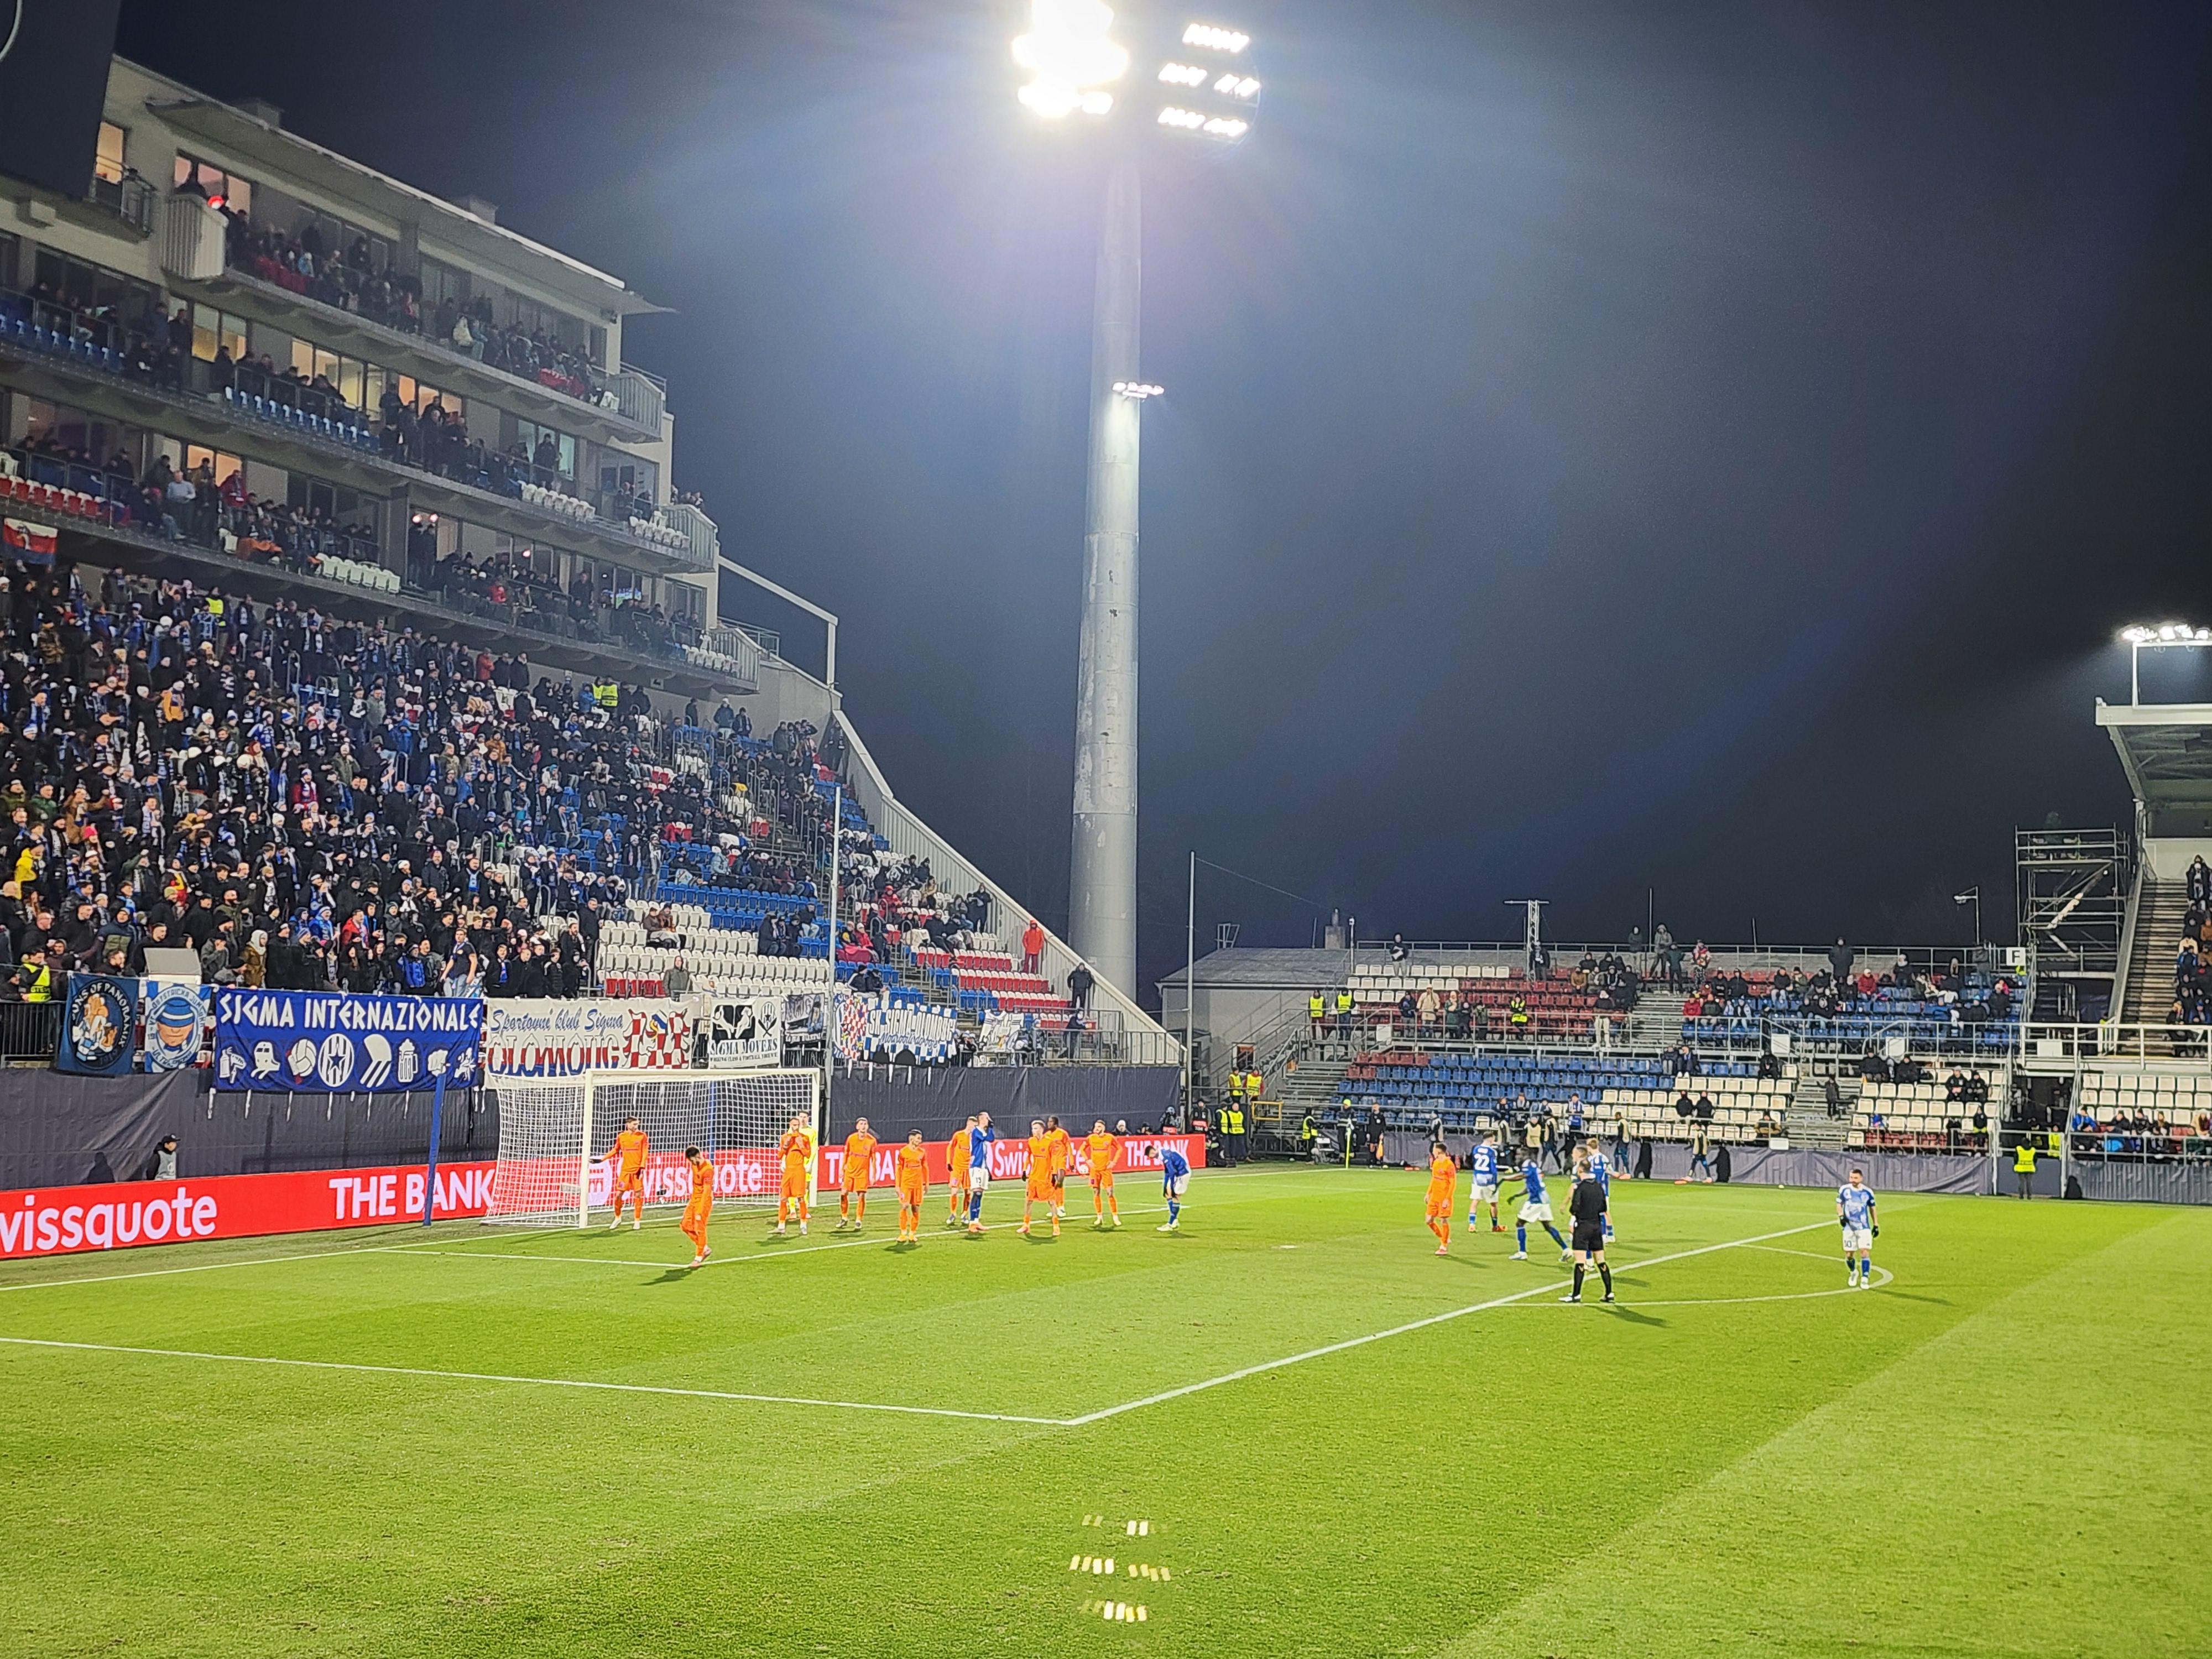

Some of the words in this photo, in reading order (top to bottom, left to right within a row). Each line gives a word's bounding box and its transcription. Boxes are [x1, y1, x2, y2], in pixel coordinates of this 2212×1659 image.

[2012, 950, 2020, 963] F
[90, 982, 102, 994] OF
[219, 993, 294, 1028] SIGMA
[304, 998, 481, 1031] INTERNAZIONALE
[555, 1006, 582, 1031] klub
[585, 1008, 623, 1037] Sigma
[869, 1010, 881, 1036] SK
[886, 1009, 912, 1035] SIGMA
[488, 1034, 620, 1077] OLOMOUC
[1474, 1154, 1490, 1171] 22
[329, 1175, 397, 1219] THE
[405, 1168, 495, 1214] BANK
